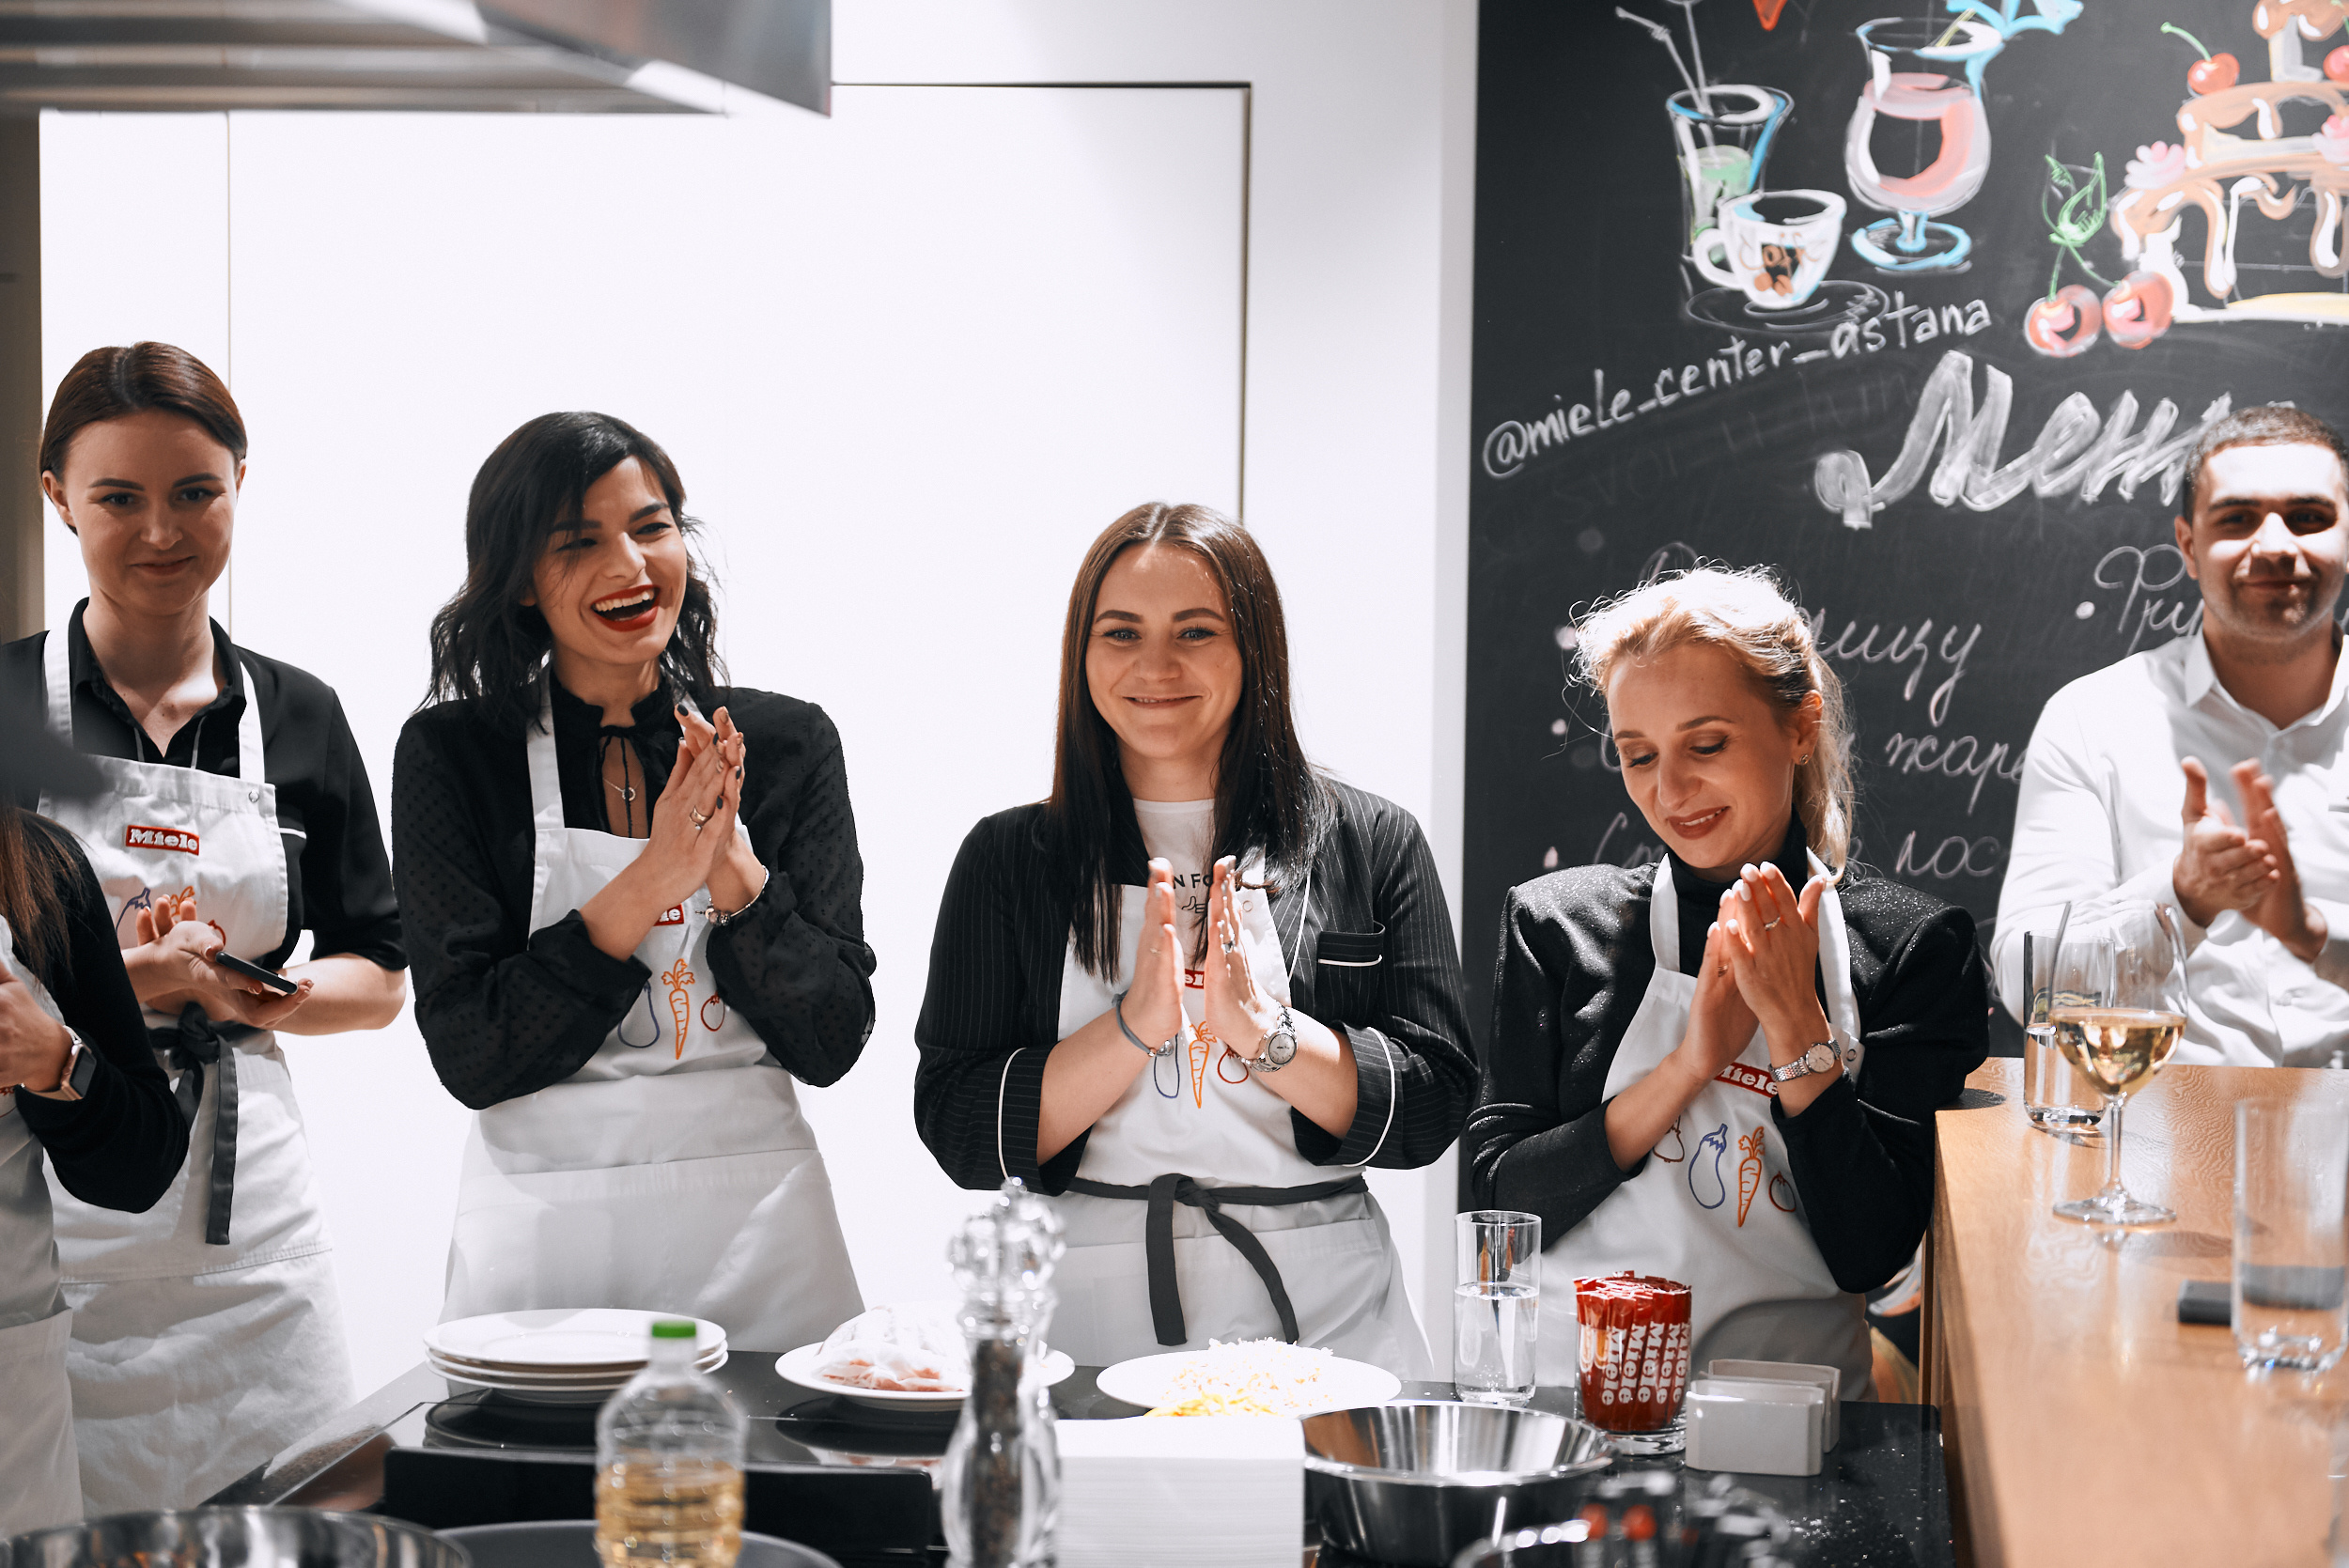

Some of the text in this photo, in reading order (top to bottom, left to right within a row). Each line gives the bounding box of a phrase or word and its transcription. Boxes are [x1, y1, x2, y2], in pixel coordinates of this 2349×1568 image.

[1484, 290, 1992, 477] @miele_center_astana
[129, 829, 198, 851] Miele
[1602, 1326, 1626, 1405] Miele
[1618, 1323, 1647, 1404] Miele
[1638, 1320, 1665, 1404] Miele
[1657, 1322, 1681, 1405] Miele
